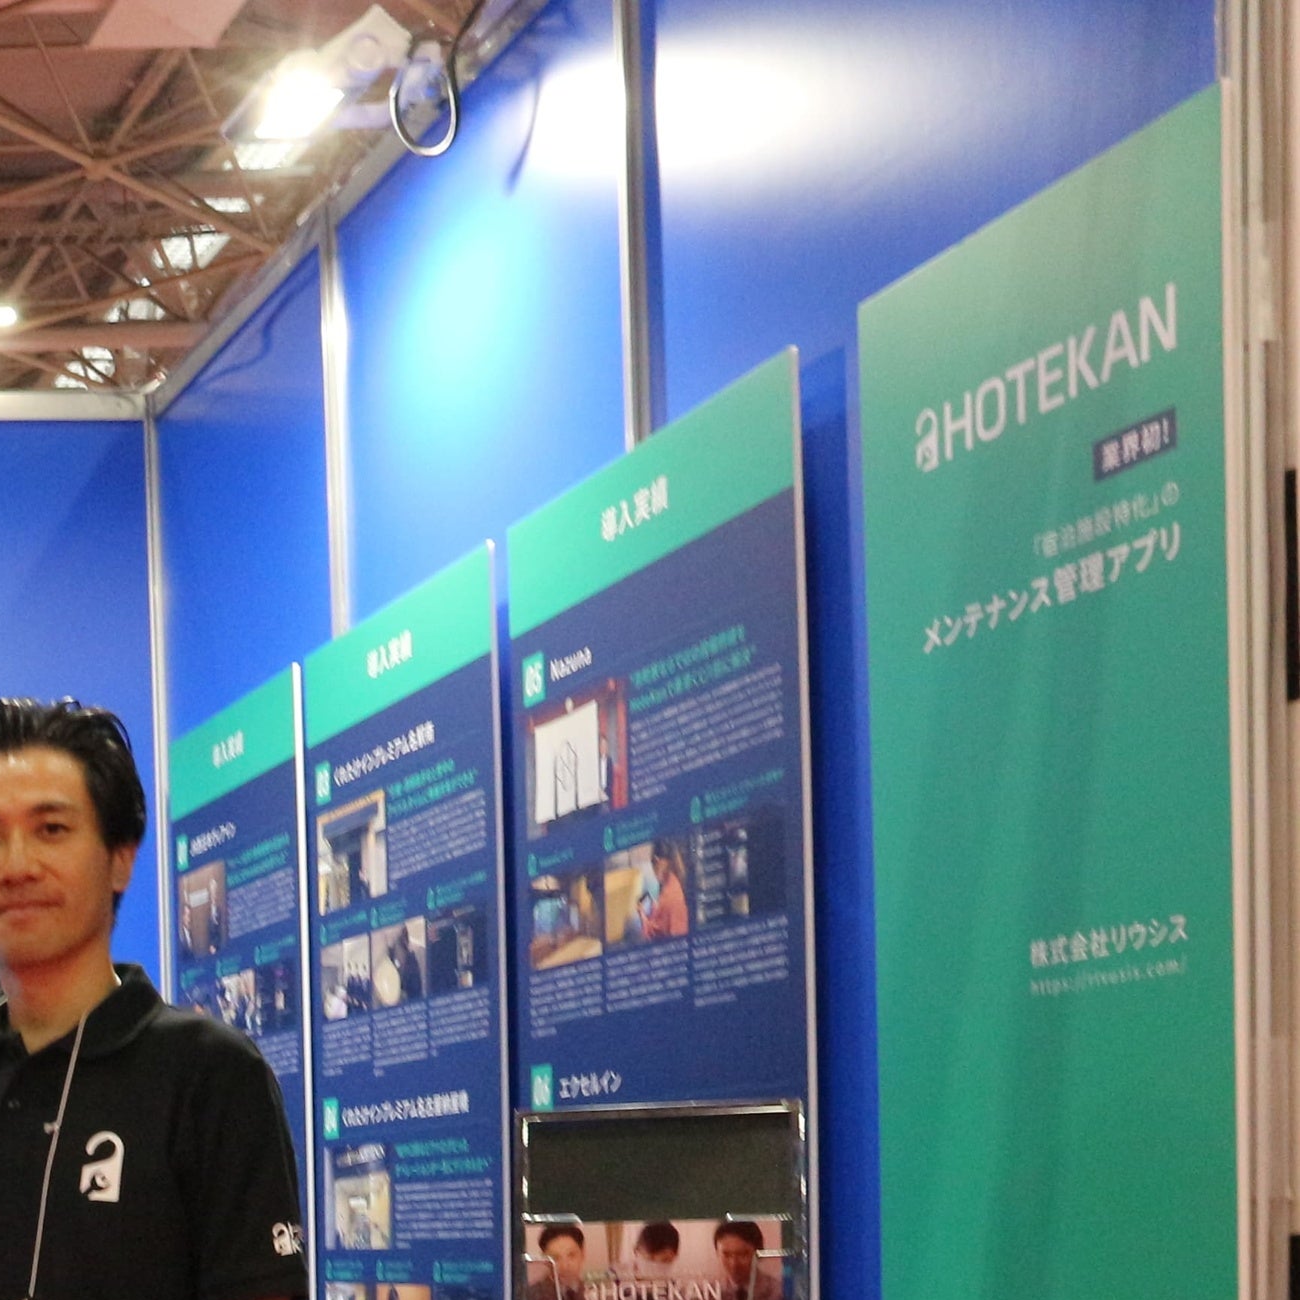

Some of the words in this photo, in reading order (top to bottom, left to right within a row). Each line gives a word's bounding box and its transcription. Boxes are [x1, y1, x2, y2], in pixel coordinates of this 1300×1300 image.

[943, 281, 1177, 461] HOTEKAN
[923, 521, 1181, 654] メンテナンス管理アプリ
